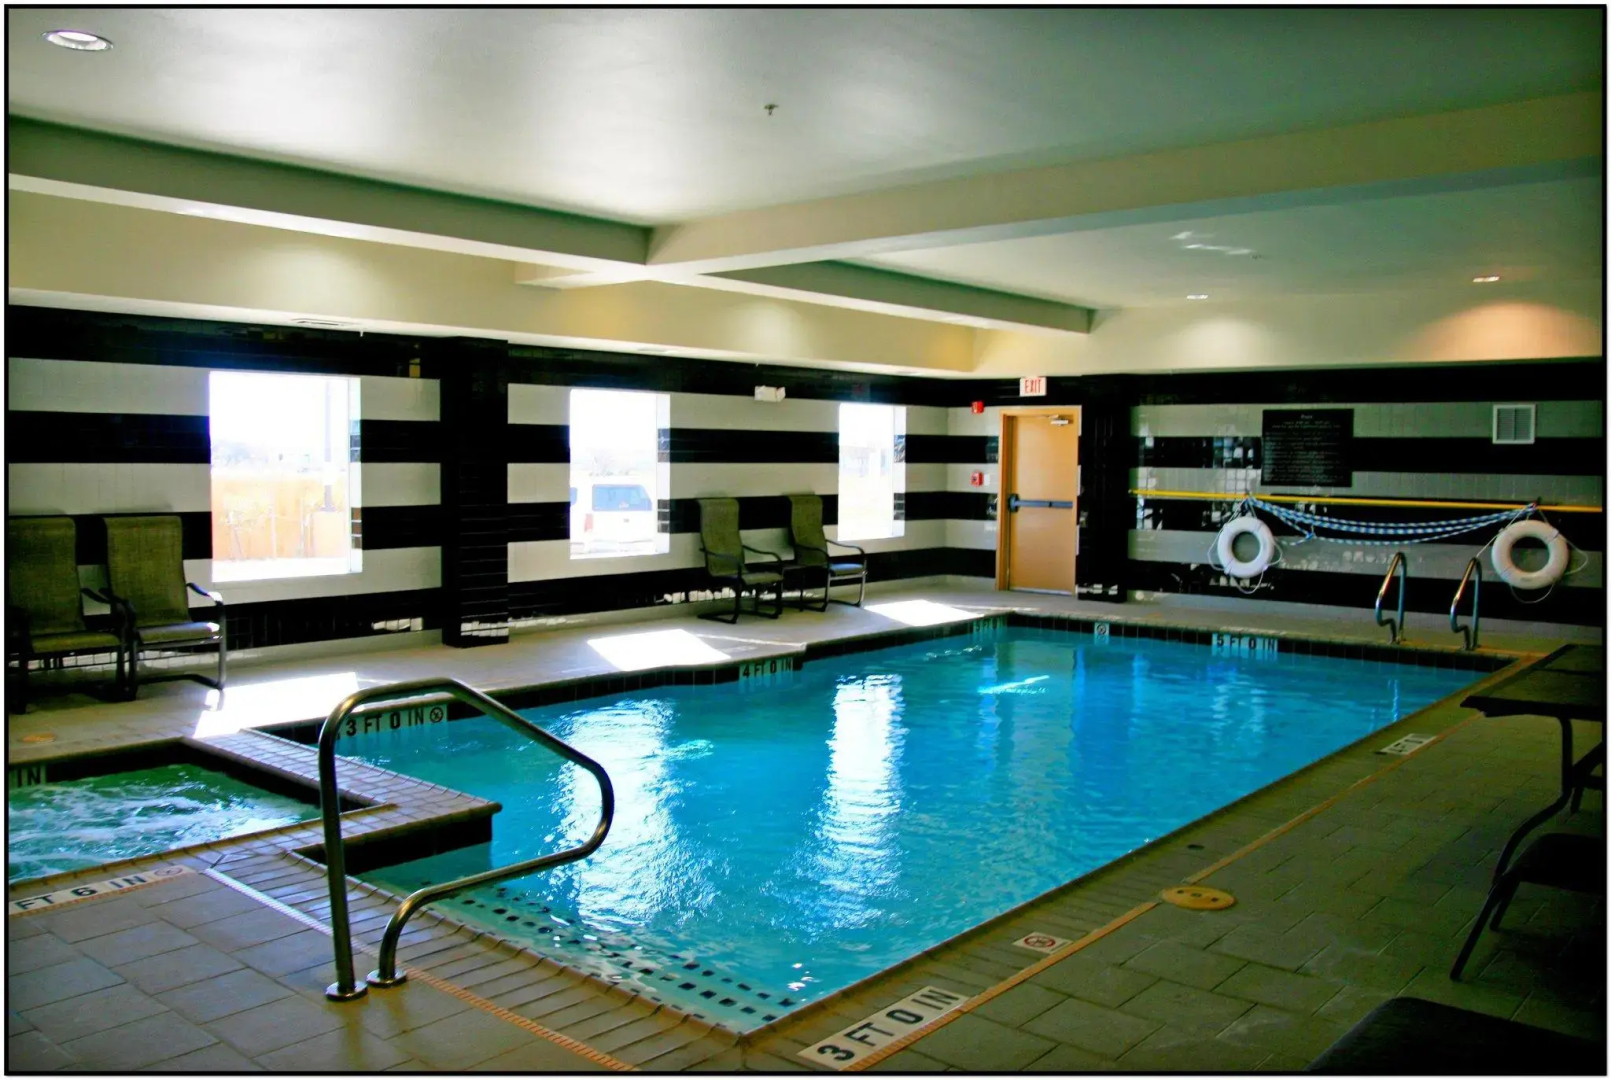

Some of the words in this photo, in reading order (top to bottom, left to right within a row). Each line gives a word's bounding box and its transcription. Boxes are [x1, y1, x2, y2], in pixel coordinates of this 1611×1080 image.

[1024, 378, 1043, 394] EXIT
[1217, 634, 1224, 647] 5
[1230, 634, 1243, 648] FT
[743, 664, 750, 679] 4
[754, 660, 766, 677] FT
[781, 658, 792, 671] IN
[346, 719, 357, 736] 3
[364, 713, 383, 734] FT
[408, 708, 424, 727] IN
[17, 767, 41, 787] IN
[15, 894, 55, 910] FT
[71, 886, 98, 897] 6
[109, 876, 146, 889] IN
[816, 1044, 856, 1062] 3
[844, 1021, 894, 1047] FT
[911, 989, 960, 1011] IN
